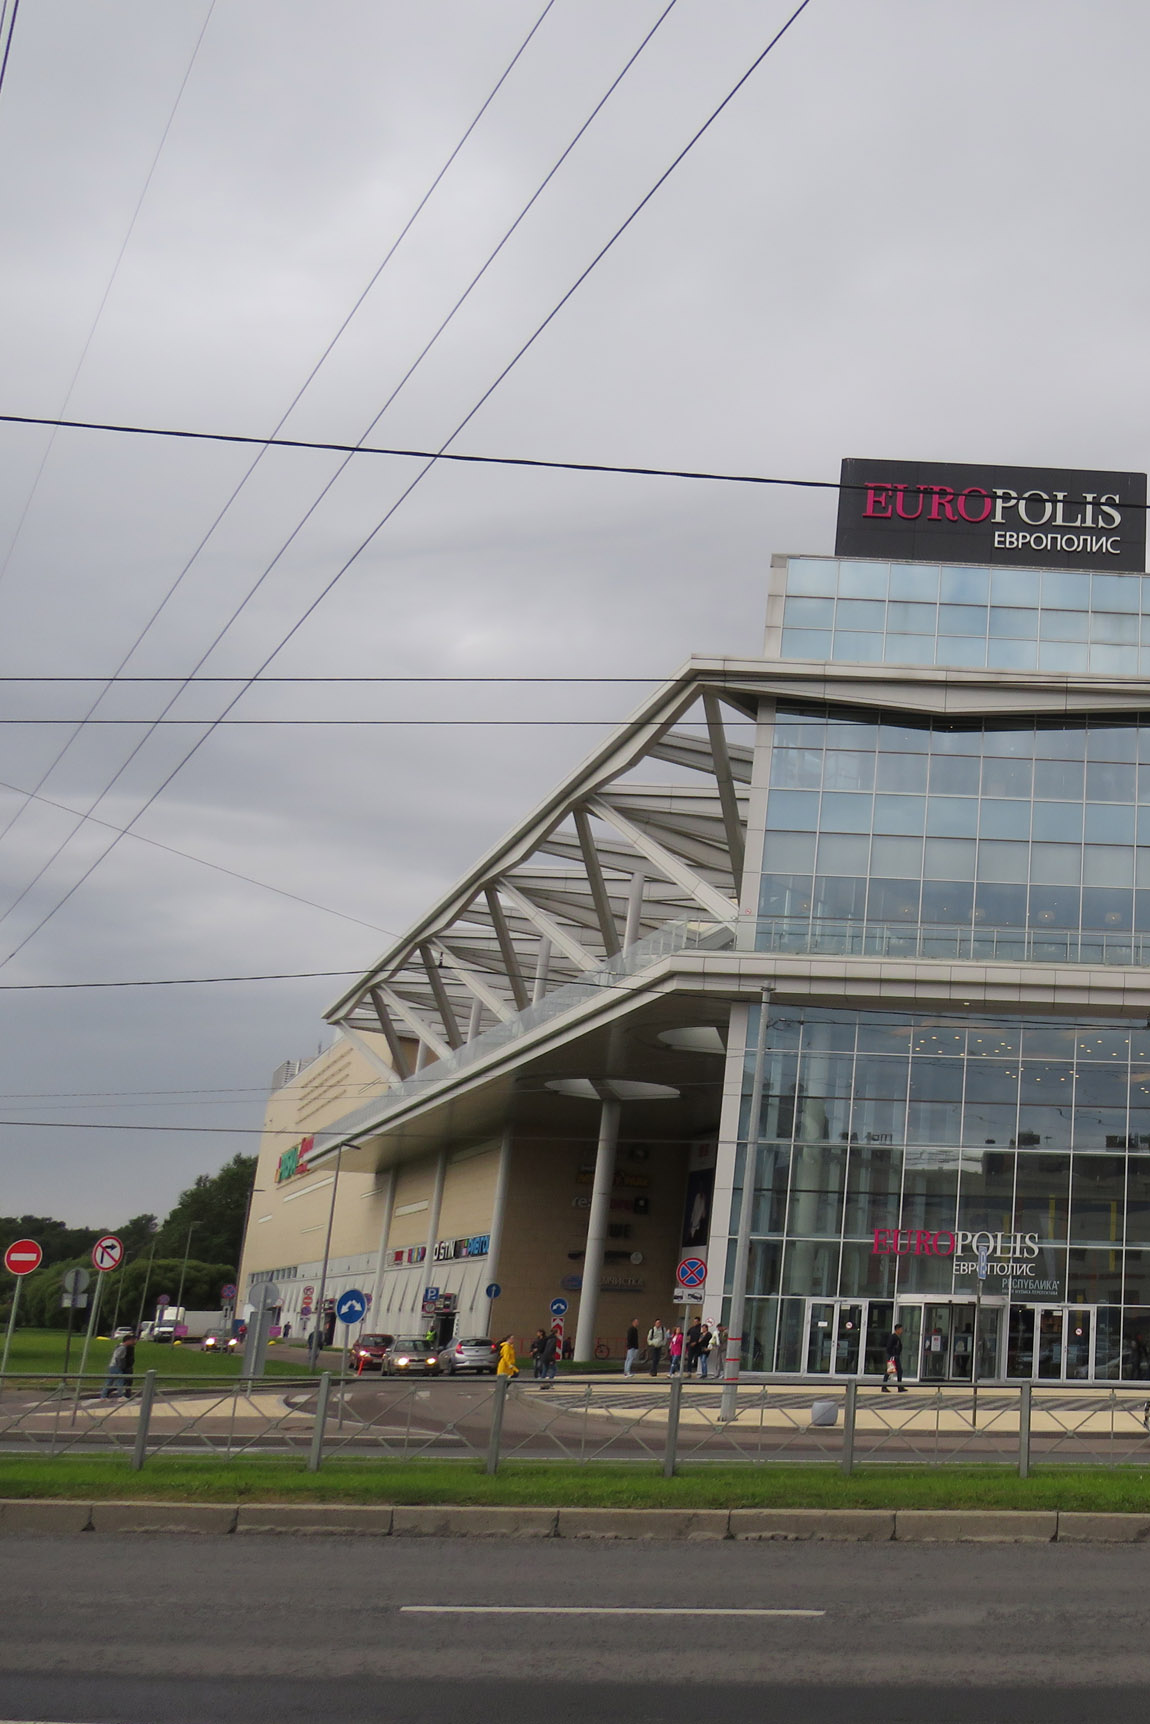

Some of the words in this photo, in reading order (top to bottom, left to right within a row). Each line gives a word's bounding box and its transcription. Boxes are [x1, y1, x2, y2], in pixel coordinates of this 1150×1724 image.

[861, 481, 1123, 530] EUROPOLIS
[993, 530, 1122, 555] ЕВРОПОЛИС
[872, 1228, 1039, 1259] EUROPOLIS
[1001, 1278, 1058, 1291] РСПУБЛИКА
